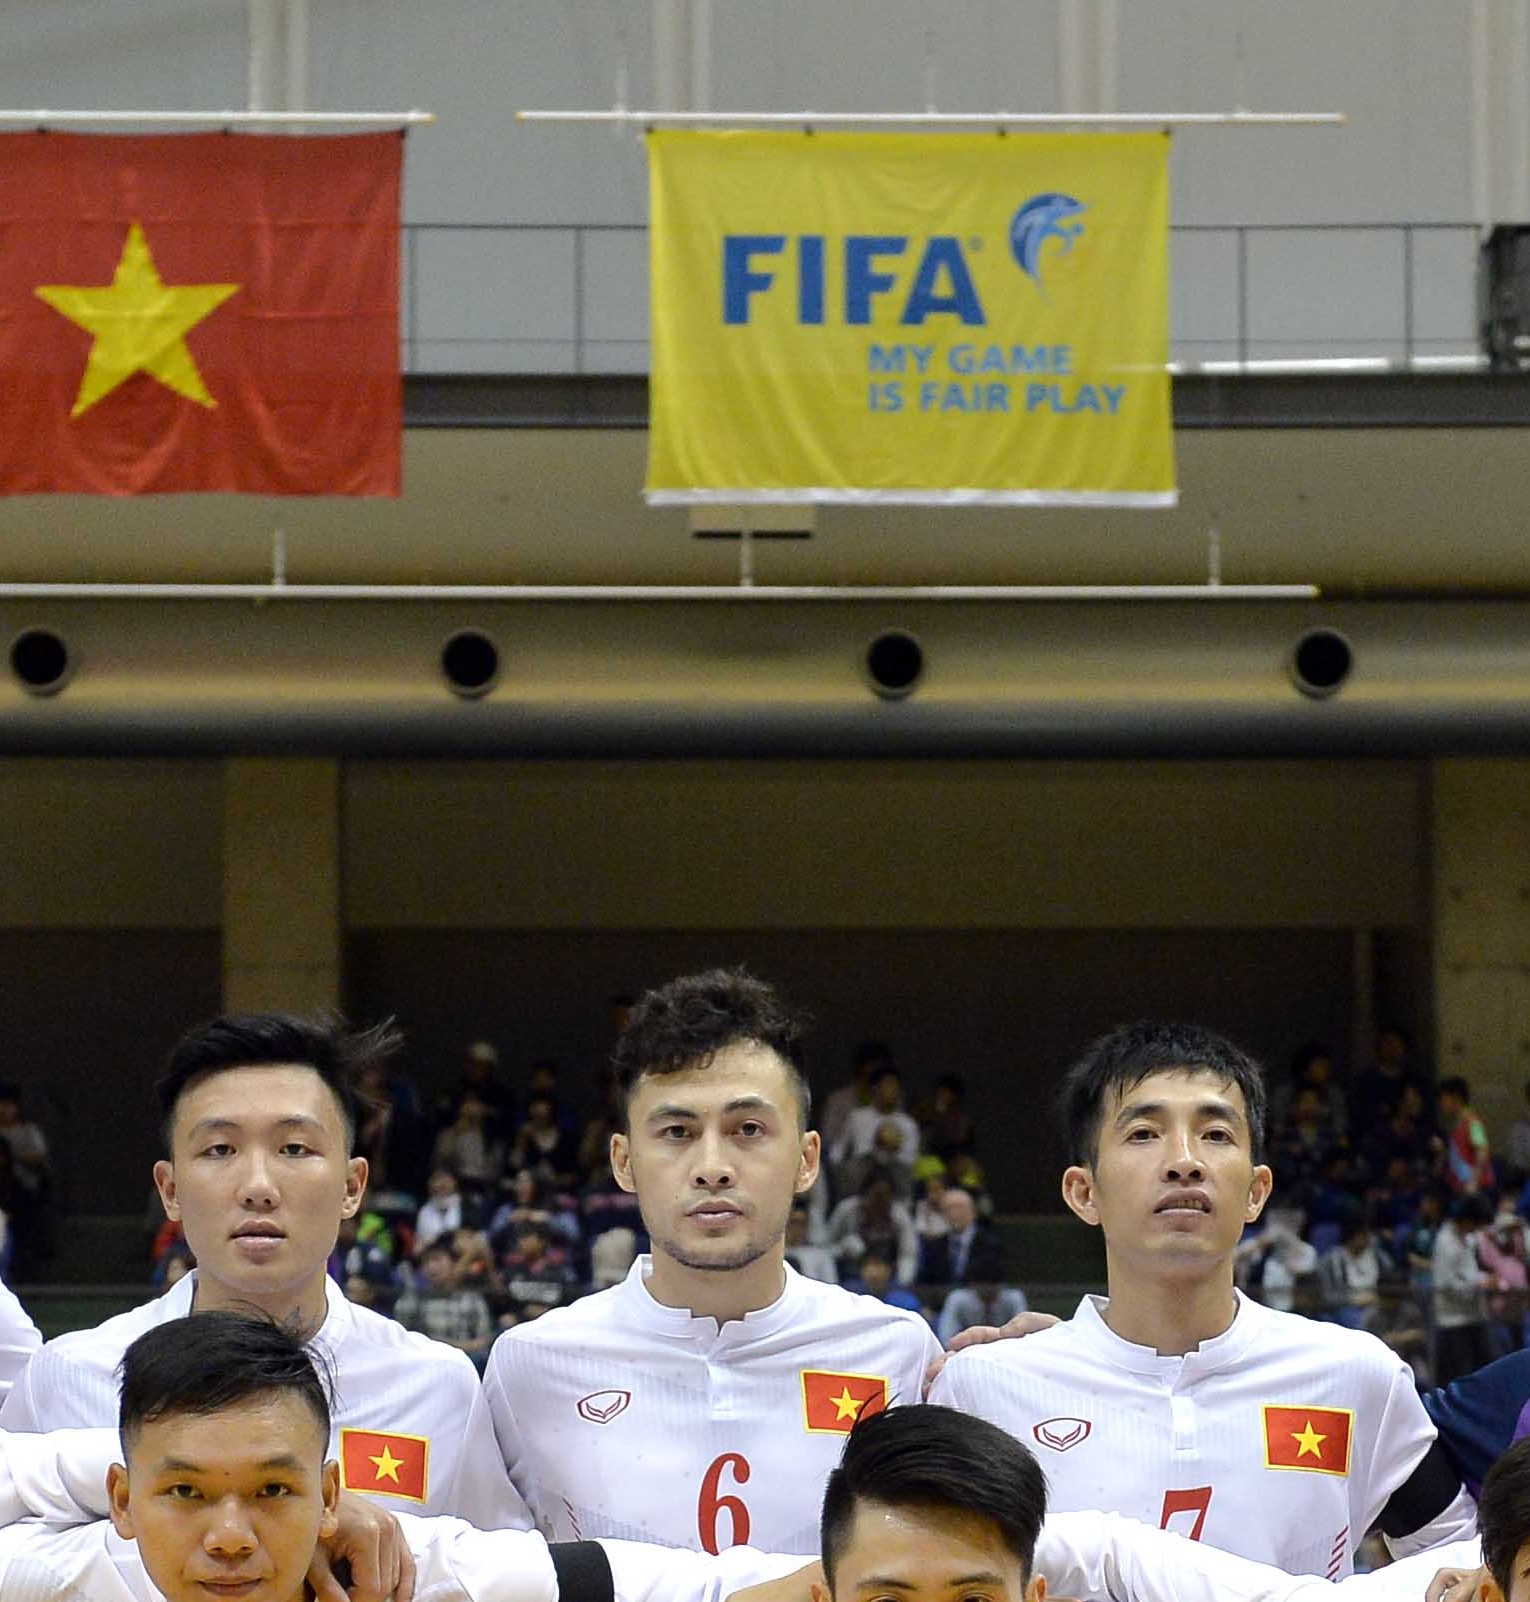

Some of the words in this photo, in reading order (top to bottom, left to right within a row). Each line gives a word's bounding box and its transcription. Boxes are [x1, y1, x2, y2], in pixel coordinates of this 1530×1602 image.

[723, 235, 986, 325] FIFA
[867, 343, 934, 375] MY
[948, 344, 1075, 376] GAME
[868, 382, 904, 413] IS
[920, 382, 1011, 413] FAIR
[1027, 383, 1127, 414] PLAY
[698, 1452, 750, 1555] 6
